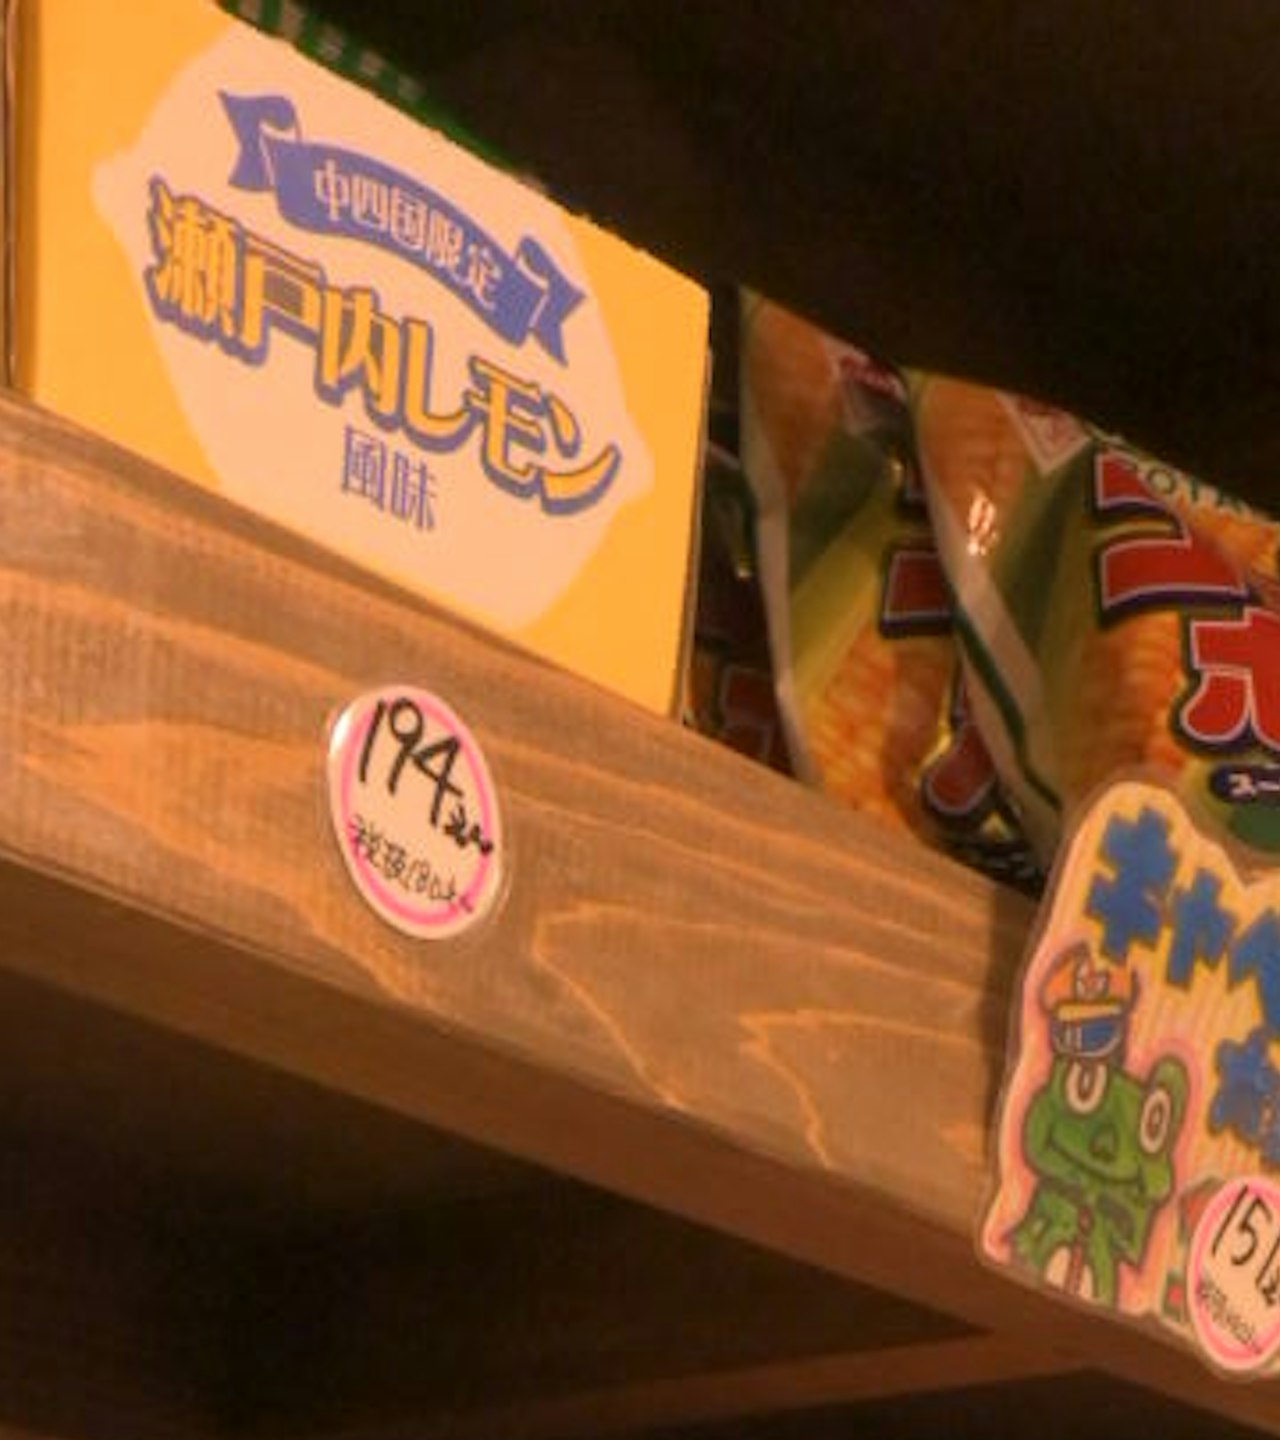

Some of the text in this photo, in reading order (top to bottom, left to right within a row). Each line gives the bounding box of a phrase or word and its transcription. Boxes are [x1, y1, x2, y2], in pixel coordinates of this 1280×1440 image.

[312, 155, 505, 312] 中四国限定
[150, 182, 622, 515] 瀬戸内レモン
[338, 425, 438, 534] 風味
